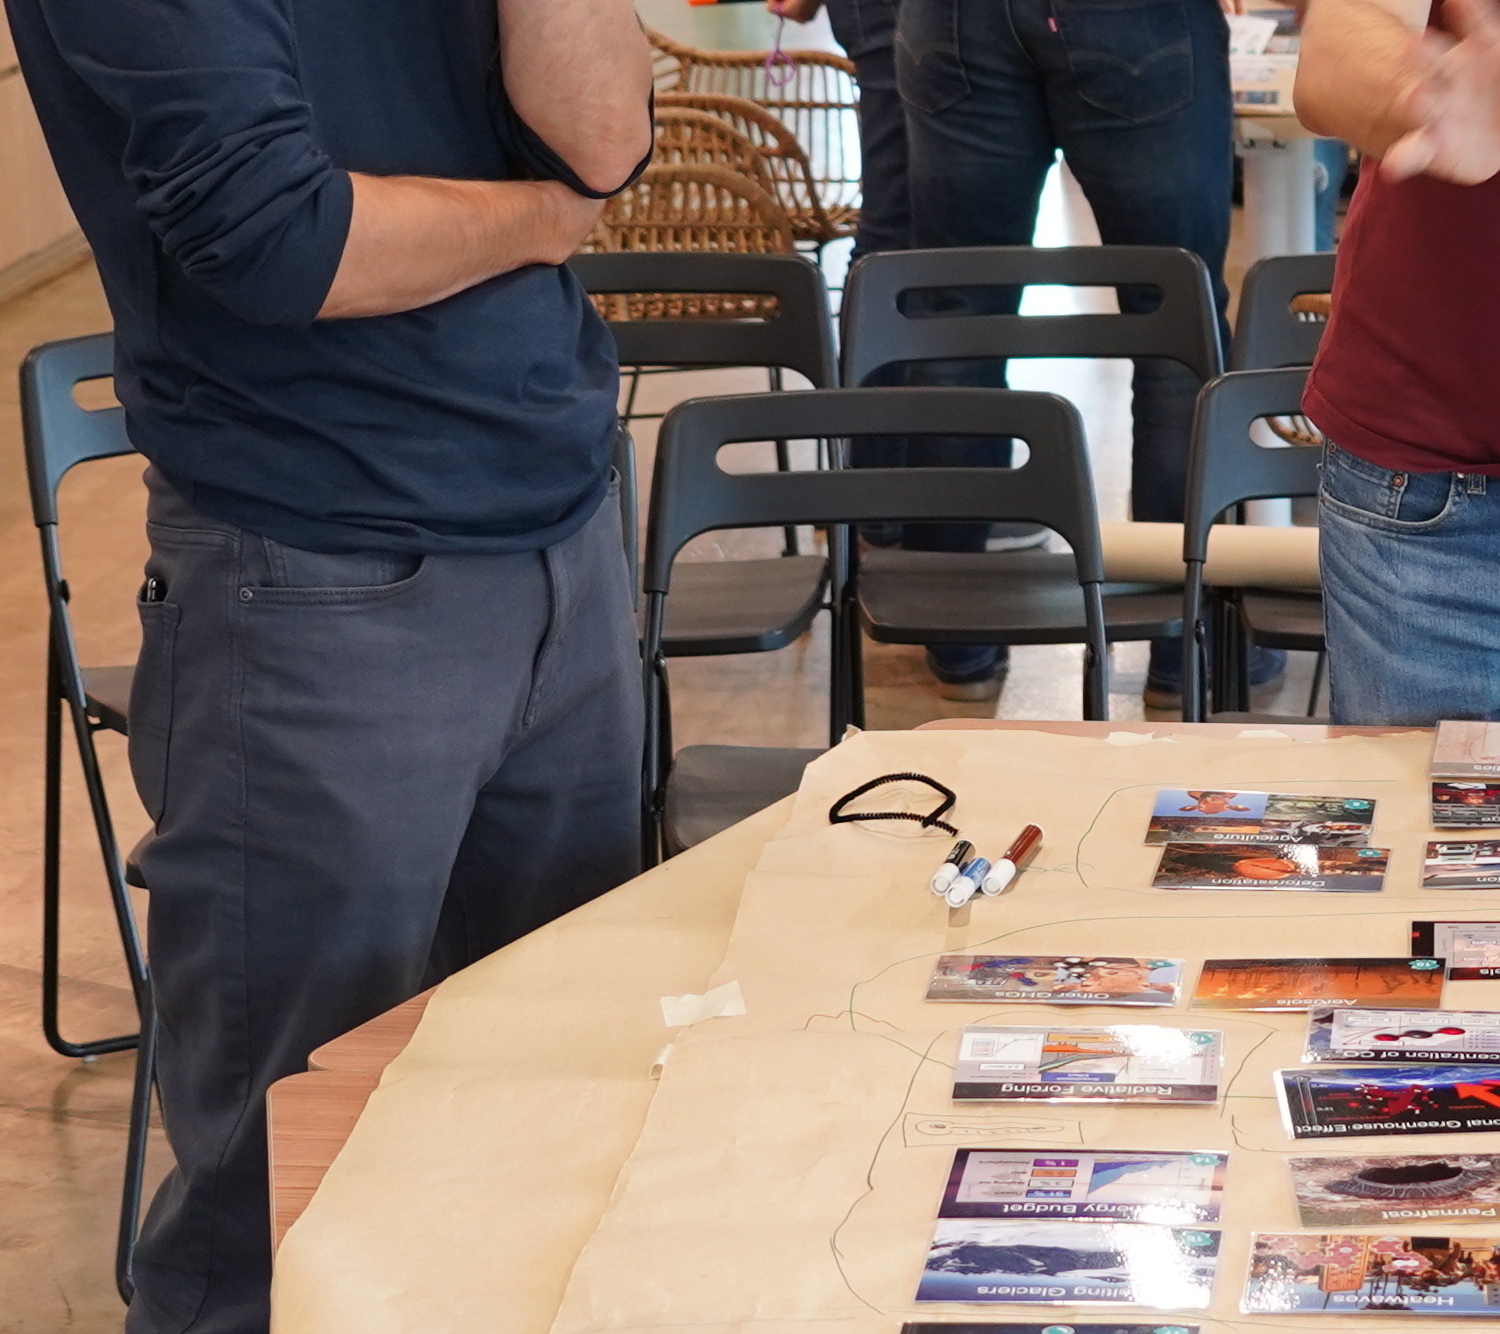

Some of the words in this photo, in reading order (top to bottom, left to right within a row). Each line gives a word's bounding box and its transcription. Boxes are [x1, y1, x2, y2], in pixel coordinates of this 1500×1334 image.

[1213, 831, 1303, 843] Agriculture
[1211, 877, 1325, 889] Deforestation
[995, 990, 1052, 999] GHGs
[1059, 992, 1109, 1000] Other
[1277, 998, 1357, 1006] Aerosols
[1379, 1051, 1399, 1059] of
[1001, 1083, 1074, 1095] Forcing
[1080, 1084, 1172, 1096] Radiative
[1296, 1124, 1346, 1134] Effect
[1352, 1120, 1460, 1131] Greenhouse
[1002, 1203, 1077, 1214] Budget
[1084, 1203, 1140, 1213] nergy
[1381, 1207, 1496, 1220] Permafrost
[977, 1286, 1066, 1297] Glaciers
[1333, 1294, 1454, 1306] Heatwaves
